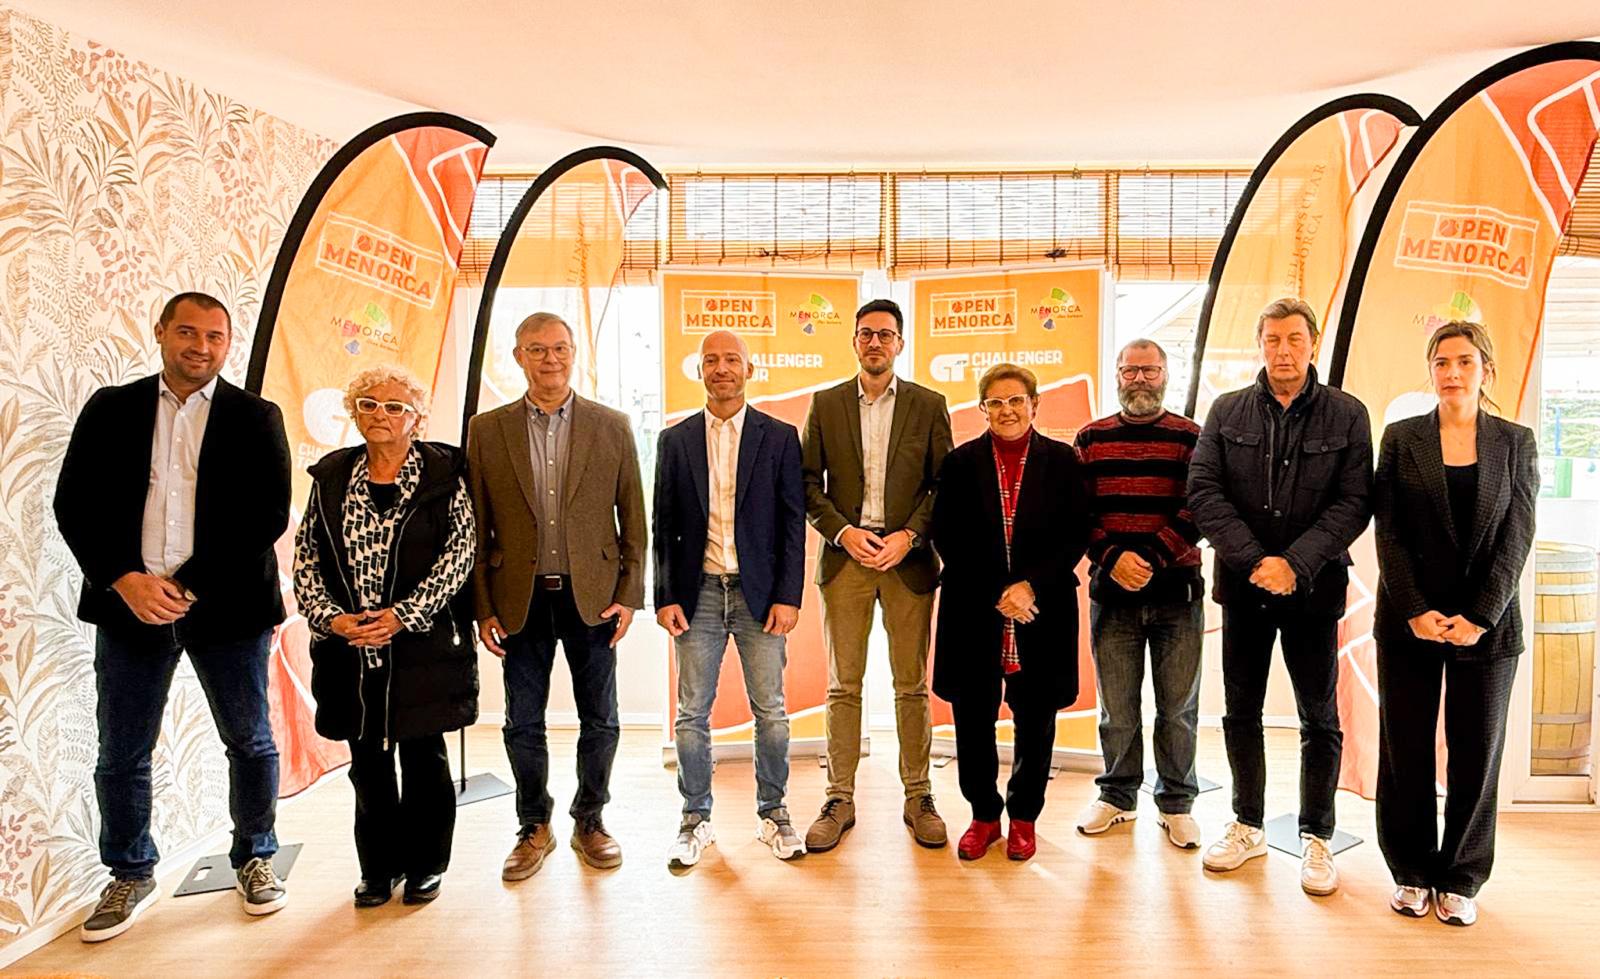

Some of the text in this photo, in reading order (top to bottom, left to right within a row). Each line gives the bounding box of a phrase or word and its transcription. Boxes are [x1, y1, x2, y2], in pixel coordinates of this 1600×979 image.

[1439, 218, 1507, 246] OPEN
[357, 234, 413, 271] OPEN
[1402, 237, 1526, 277] MENORCA
[324, 243, 431, 300] MENORCA
[705, 299, 753, 312] OPEN
[952, 299, 995, 314] OPEN
[1030, 305, 1081, 315] MENORCA
[686, 313, 773, 328] MENORCA
[790, 310, 840, 319] MENORCA
[934, 312, 1014, 330] MENORCA
[330, 316, 398, 346] MENORCA
[751, 353, 823, 369] ALLENGER
[972, 350, 1063, 367] CHALLENGER
